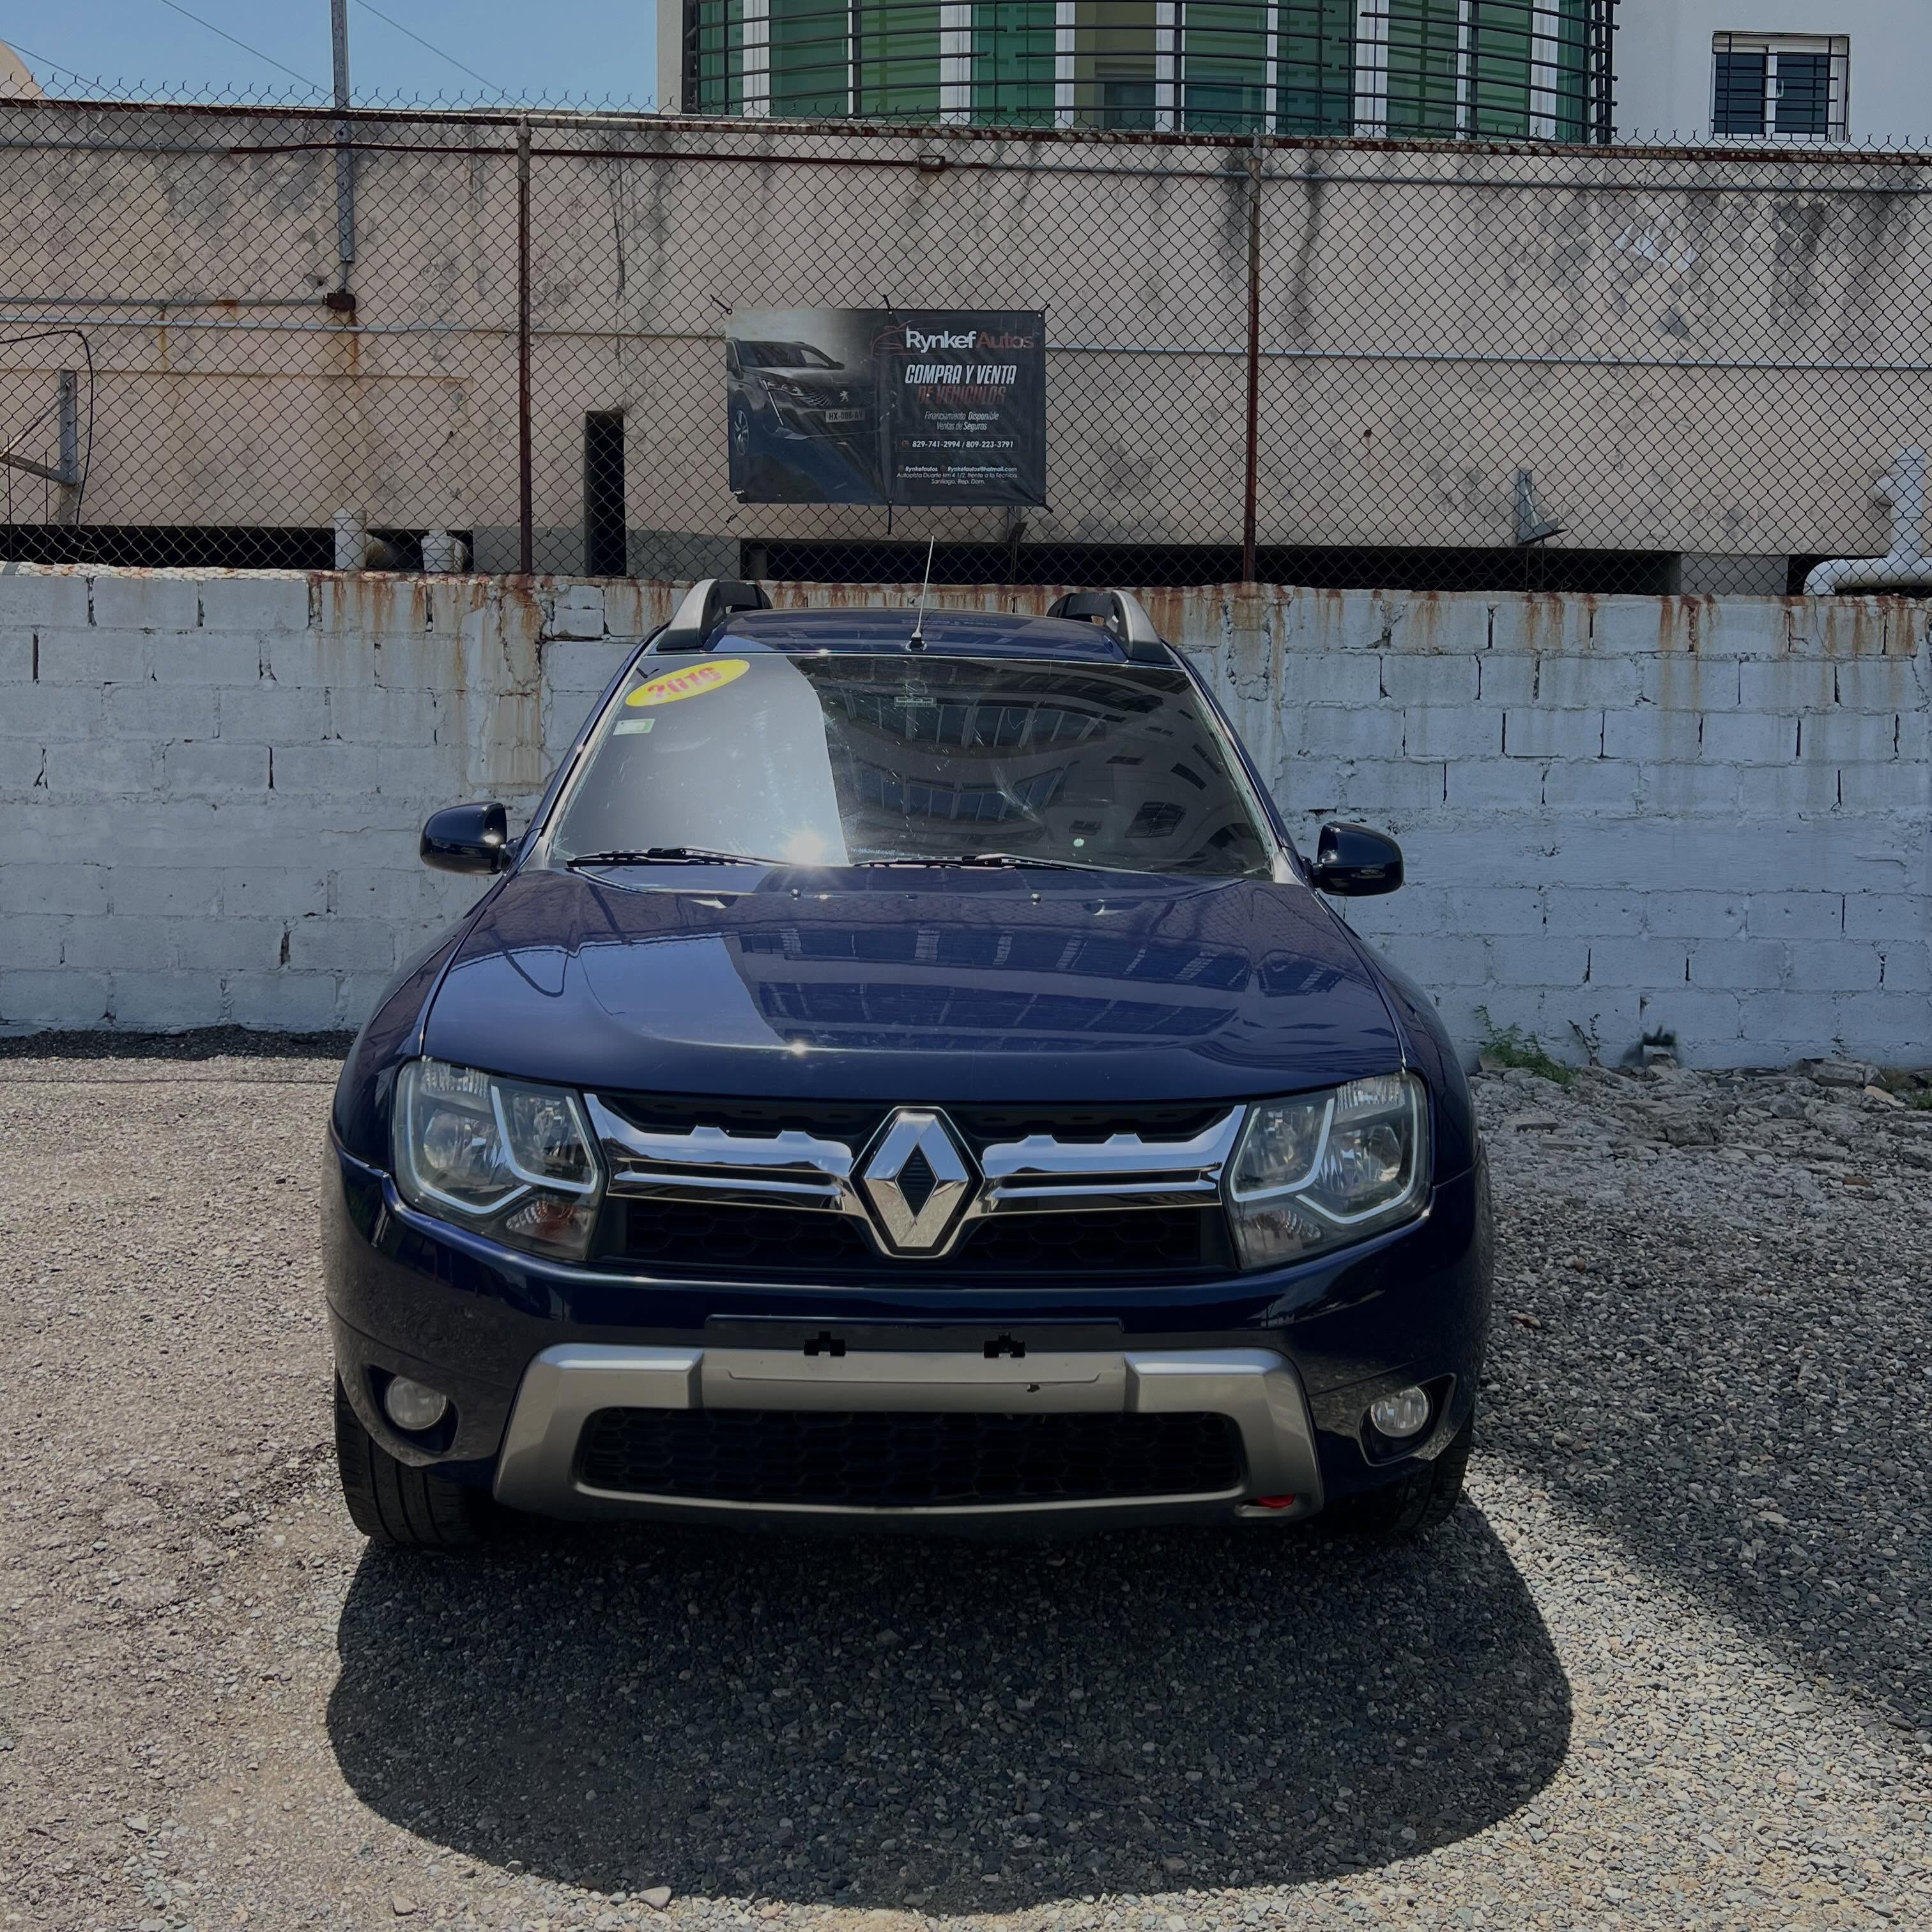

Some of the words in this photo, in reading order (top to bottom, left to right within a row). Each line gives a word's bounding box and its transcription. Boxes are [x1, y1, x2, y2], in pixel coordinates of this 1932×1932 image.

[906, 328, 976, 353] Rynkef
[976, 332, 1034, 349] Autos
[905, 364, 963, 384] COMPRA
[965, 365, 976, 384] Y
[976, 365, 1017, 385] VENTA
[924, 411, 966, 420] Financiamiento
[968, 411, 999, 421] Disponible
[937, 422, 954, 431] Ventas
[963, 422, 988, 432] Seguros
